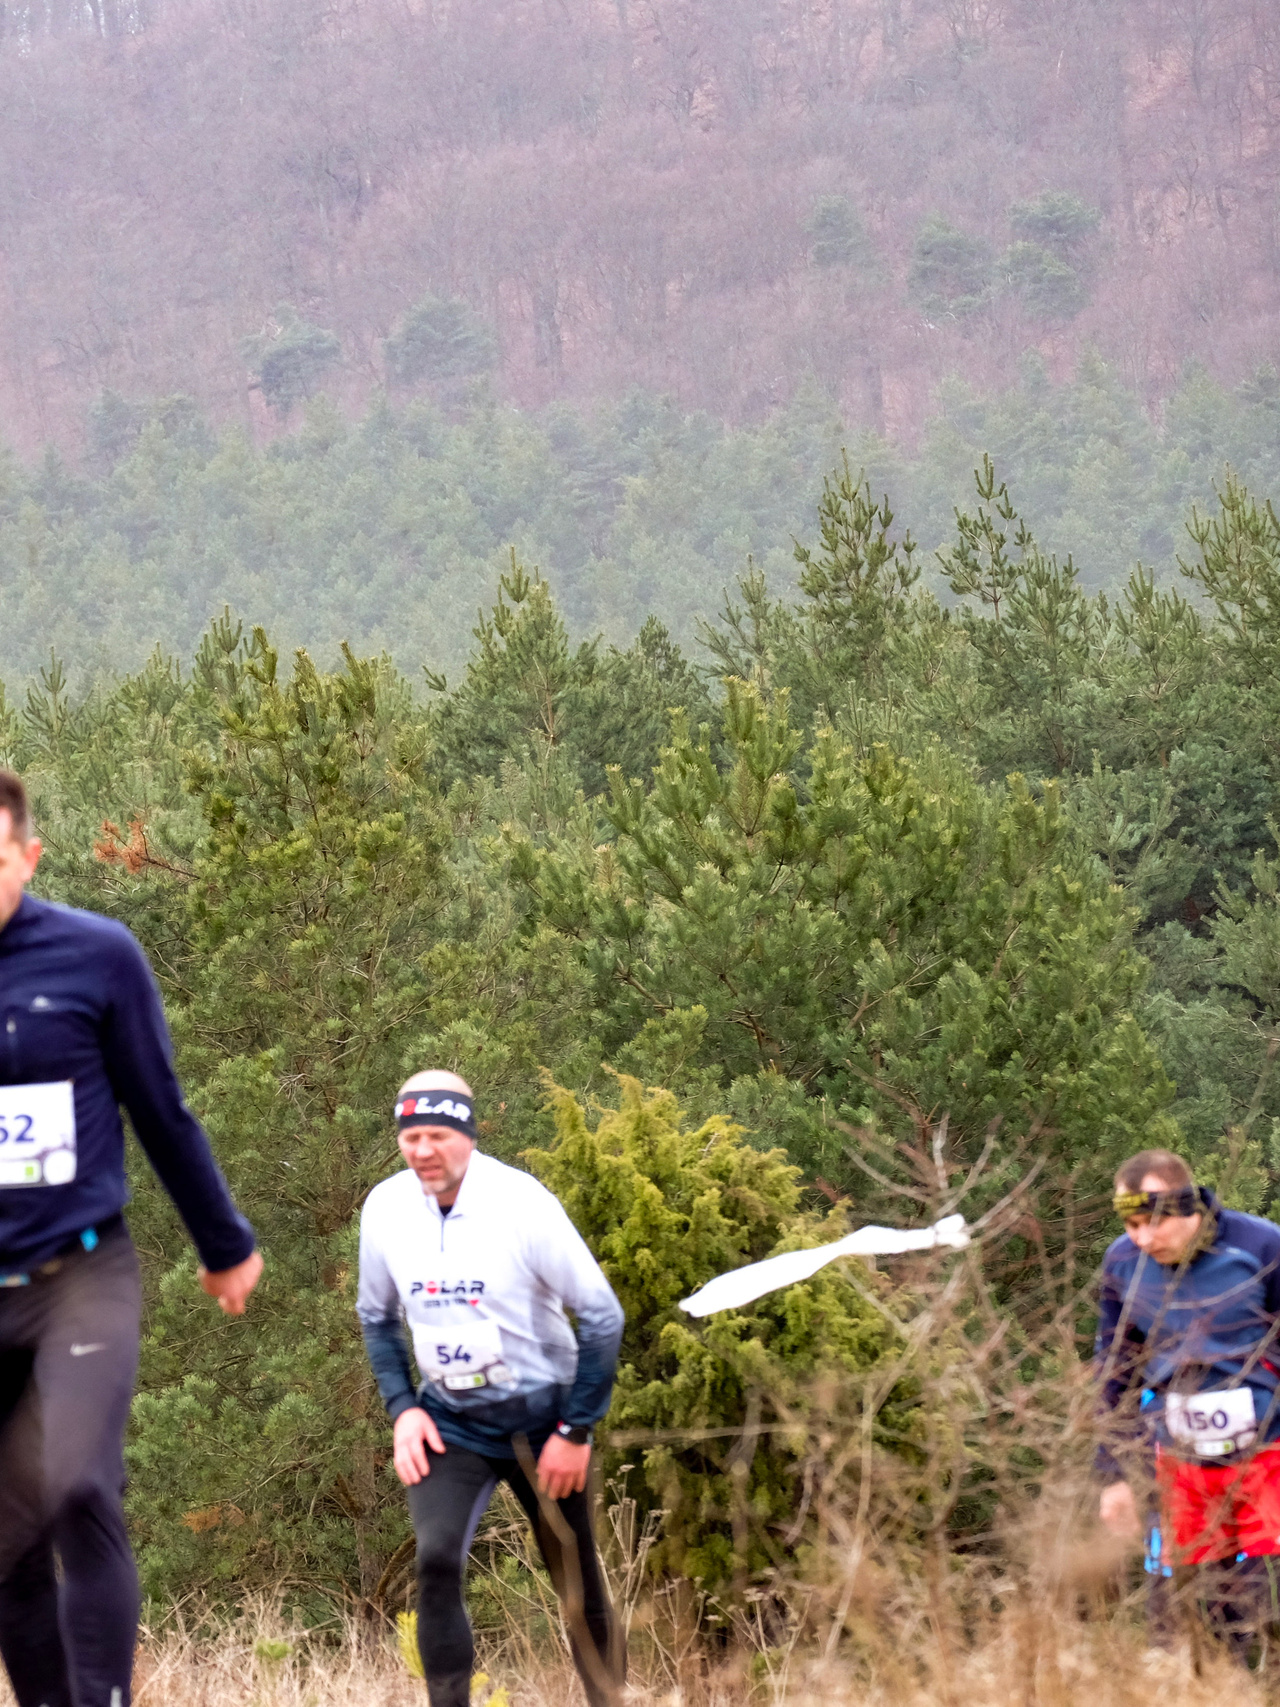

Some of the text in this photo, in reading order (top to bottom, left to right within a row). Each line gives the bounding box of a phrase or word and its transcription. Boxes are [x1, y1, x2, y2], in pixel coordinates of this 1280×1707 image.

[410, 1280, 485, 1297] POLAR
[436, 1344, 472, 1366] 54
[1183, 1409, 1228, 1430] 150
